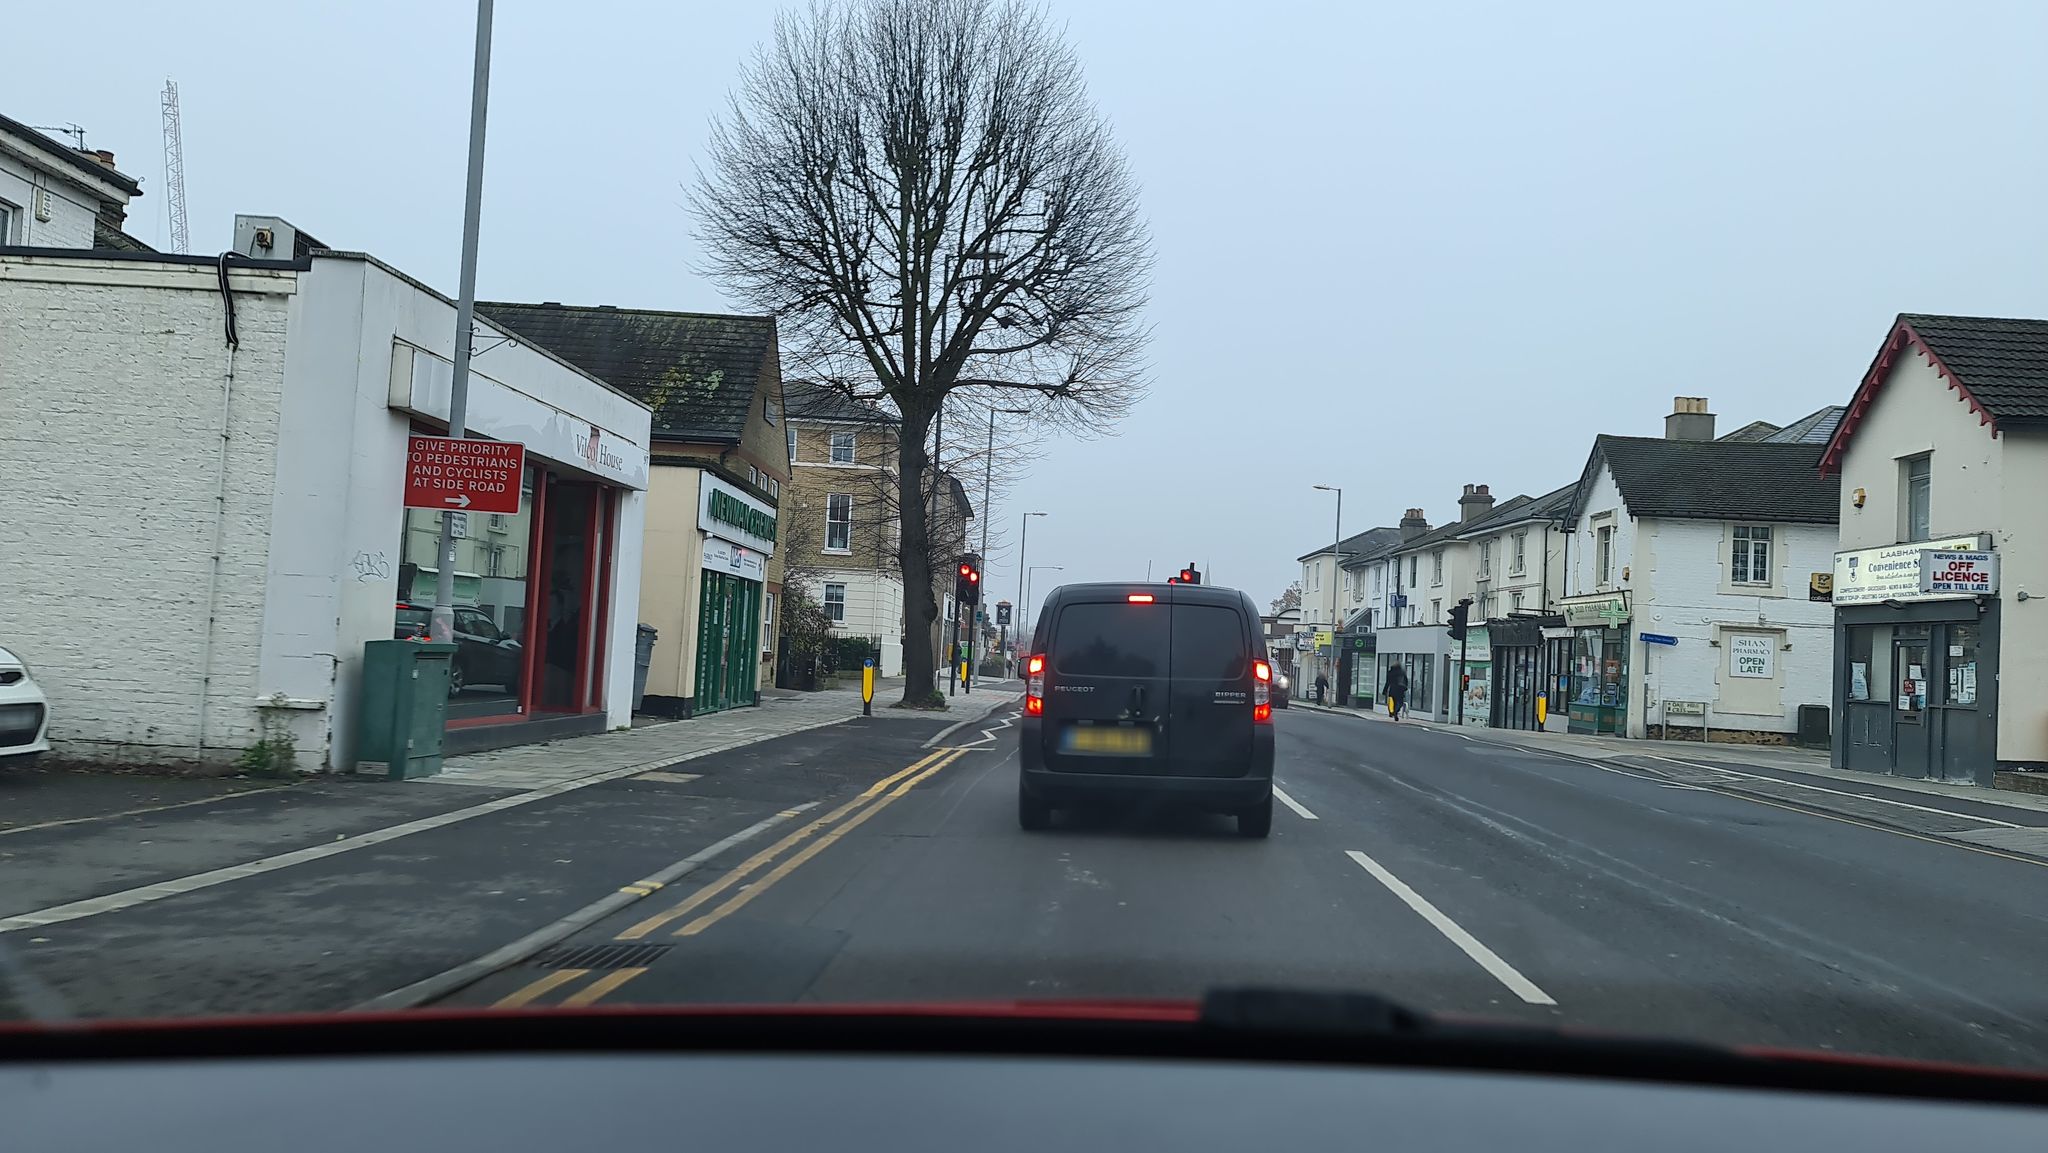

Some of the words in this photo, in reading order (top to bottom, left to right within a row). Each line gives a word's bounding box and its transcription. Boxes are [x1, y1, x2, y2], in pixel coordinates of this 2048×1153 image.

[415, 440, 446, 452] GIVE
[450, 442, 511, 456] PRIORITY
[576, 433, 599, 462] Vilcol
[599, 443, 623, 471] House
[408, 452, 422, 463] TO
[426, 453, 518, 469] PEDESTRIANS
[412, 465, 442, 476] AND
[446, 466, 508, 481] CYCLISTS
[413, 477, 430, 488] AT
[433, 478, 464, 490] SIDE
[469, 481, 506, 493] ROAD
[1934, 553, 1957, 561] NEWS
[1868, 560, 1911, 573] Convenience
[1948, 561, 1975, 572] OFF
[1932, 571, 1989, 583] LICENCE
[1932, 582, 1952, 590] OPEN
[1971, 583, 1989, 591] LATE
[1739, 656, 1765, 666] OPEN
[1740, 665, 1764, 674] LATE
